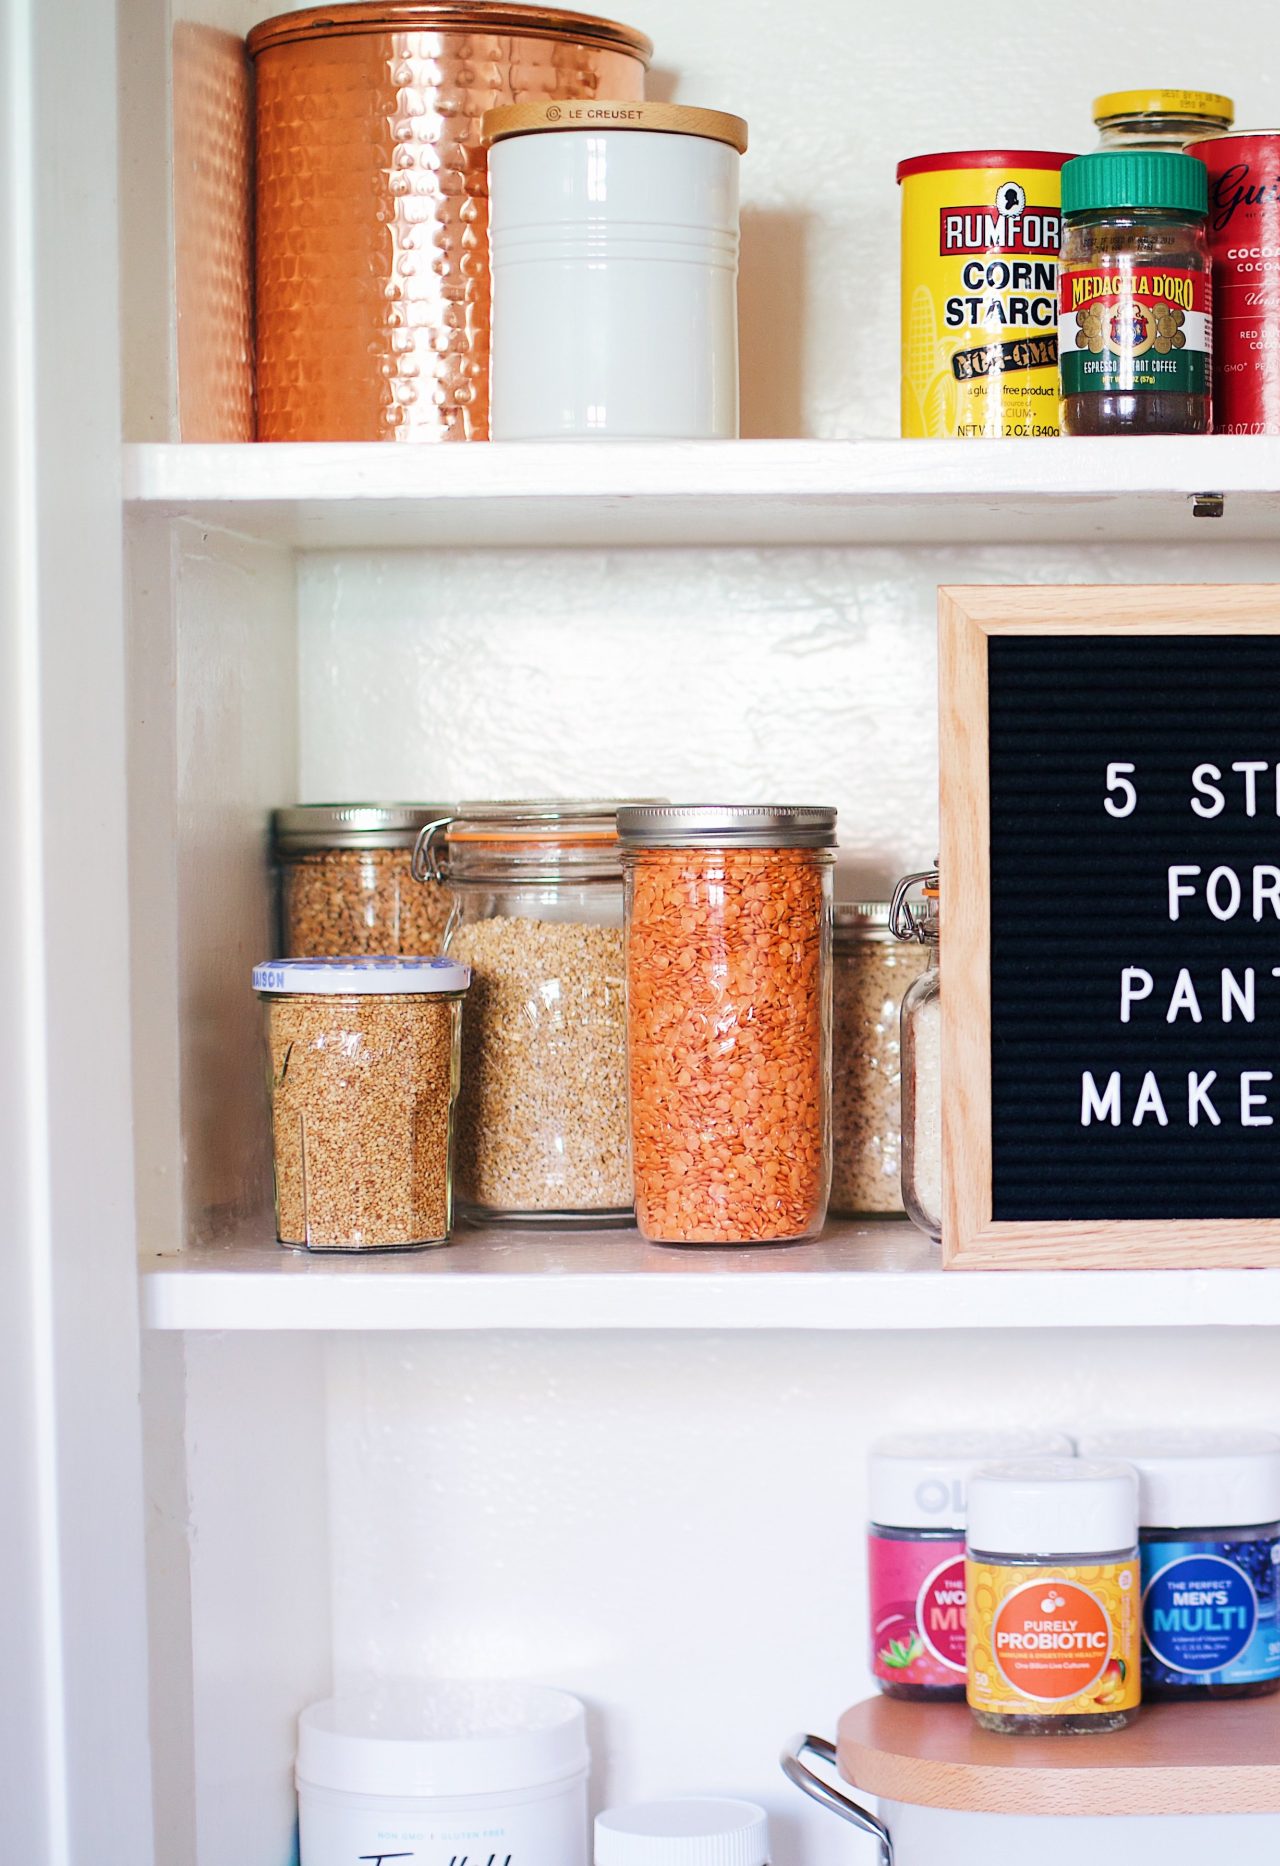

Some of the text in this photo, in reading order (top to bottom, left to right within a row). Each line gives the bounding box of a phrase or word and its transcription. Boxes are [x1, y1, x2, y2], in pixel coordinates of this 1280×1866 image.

[569, 109, 644, 120] LE CREUSET
[1237, 262, 1280, 273] COCOA
[963, 261, 1055, 291] CORN
[1153, 273, 1193, 311] D'ORO
[946, 297, 1058, 327] STARC
[1240, 330, 1258, 339] RED
[1084, 361, 1117, 374] ESPRESSO
[1152, 360, 1177, 373] COFFEE
[1003, 385, 1020, 396] free
[1021, 385, 1055, 399] product
[1104, 762, 1137, 818] 5
[944, 1580, 963, 1589] THE
[1167, 1580, 1232, 1591] THE PERFECT
[1173, 1590, 1229, 1606] MEN'S
[1023, 1620, 1078, 1632] PURELY
[1153, 1606, 1247, 1632] MULTI
[997, 1632, 1106, 1650] PROBIOTIC
[440, 1831, 480, 1841] GLUTEN
[483, 1828, 505, 1837] FREE
